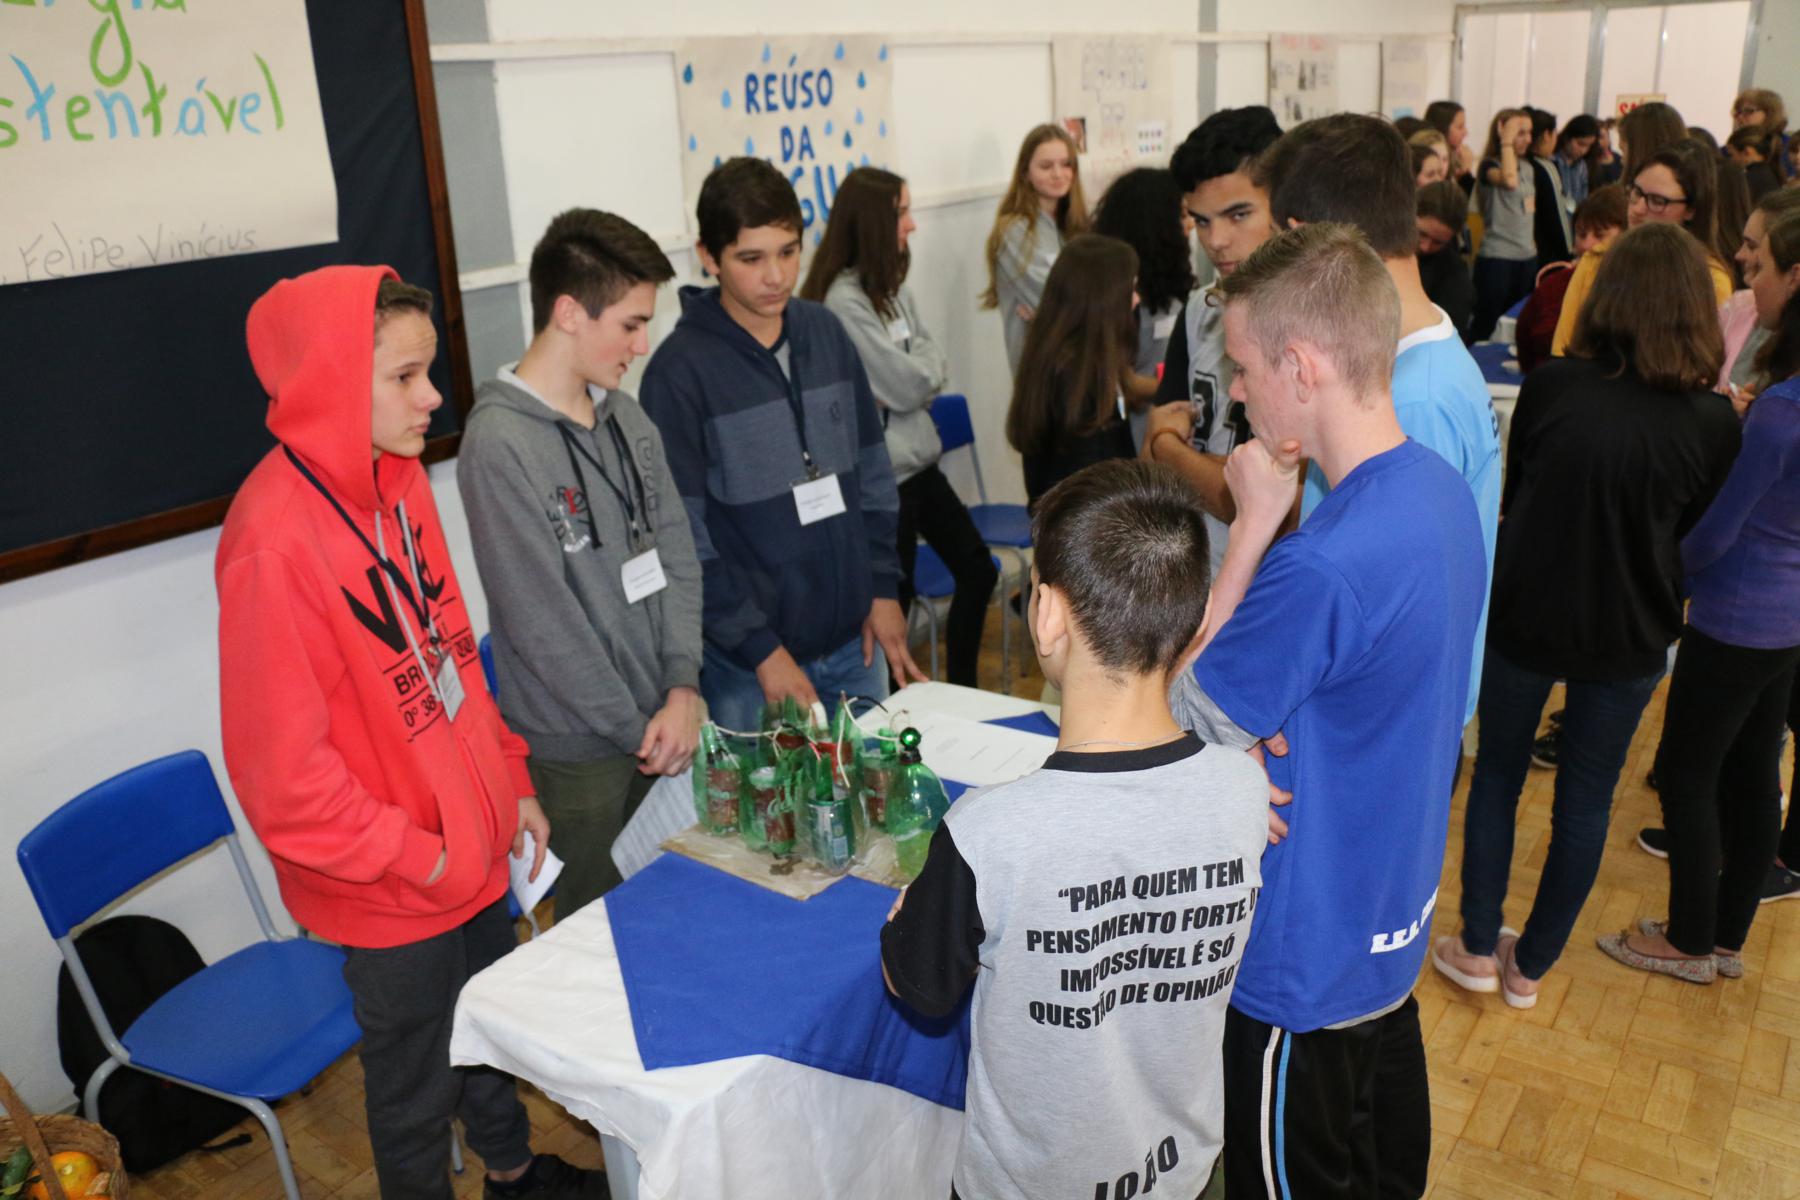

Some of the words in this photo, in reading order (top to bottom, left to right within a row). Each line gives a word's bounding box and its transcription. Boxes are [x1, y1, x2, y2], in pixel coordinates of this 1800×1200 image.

[745, 53, 833, 114] REÚSO
[780, 125, 815, 163] DA
[1132, 866, 1197, 900] QUEM
[1203, 857, 1244, 889] TEM
[1026, 910, 1177, 953] PENSAMENTO
[1060, 944, 1187, 993] IMPOSSÍVEL
[1191, 940, 1204, 967] É
[1208, 932, 1236, 962] SÓ
[1029, 988, 1117, 1029] QUESTÃO
[1119, 982, 1149, 1006] DE
